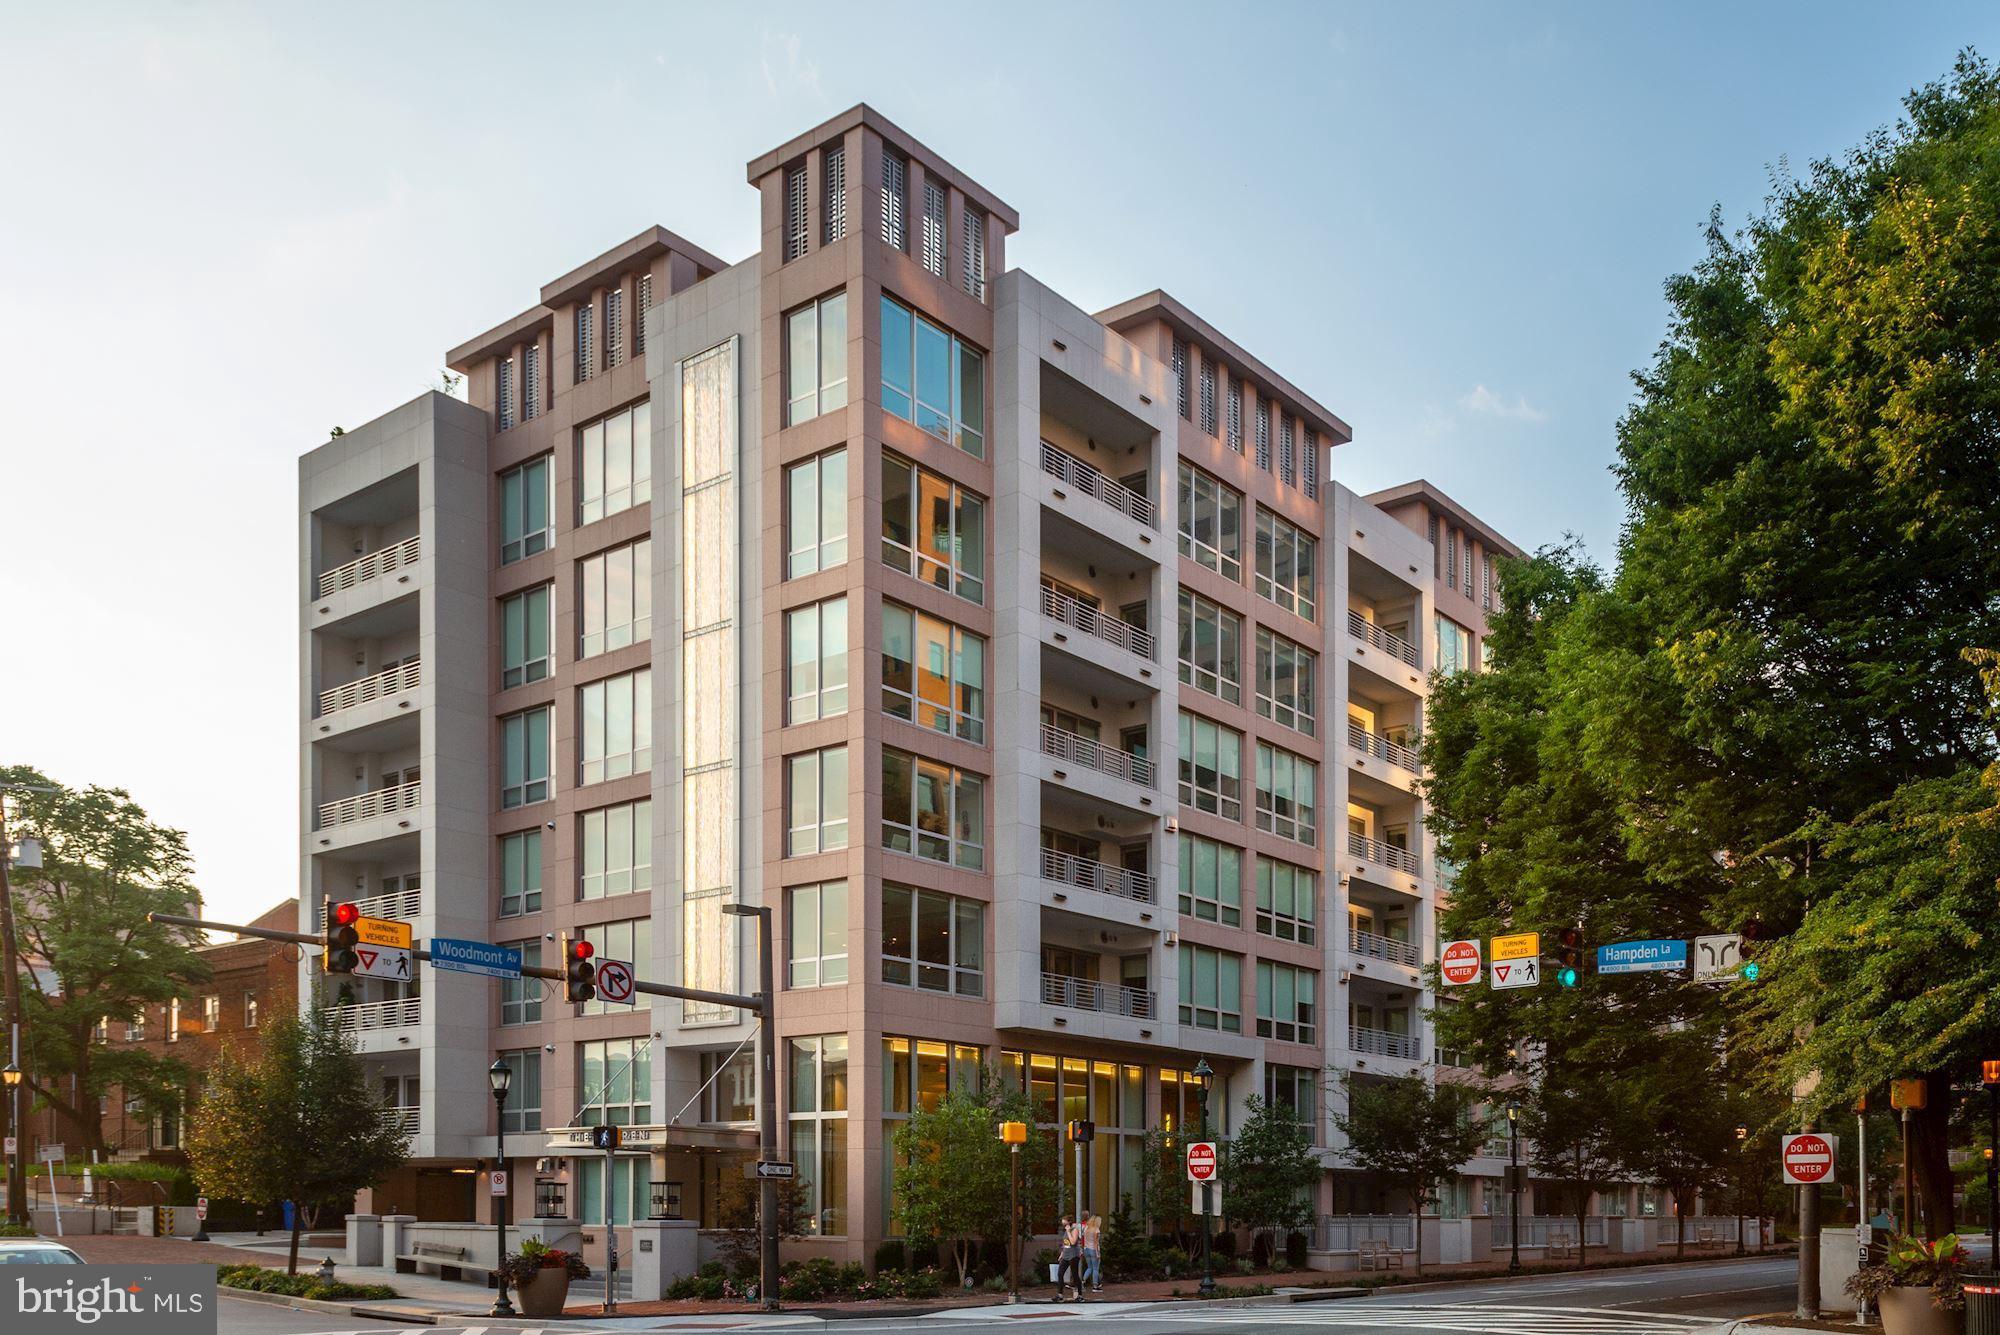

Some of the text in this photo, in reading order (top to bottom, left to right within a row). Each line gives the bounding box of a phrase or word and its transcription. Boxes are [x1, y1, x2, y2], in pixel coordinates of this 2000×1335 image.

[368, 922, 399, 934] TURNING
[365, 932, 400, 944] VEHICLES
[1502, 939, 1527, 948] TURNING
[438, 941, 518, 964] Woodmont Av
[1447, 948, 1474, 959] DO NOT
[1500, 947, 1529, 957] VEHICLES
[1605, 943, 1671, 962] Hampden La
[382, 958, 392, 966] TO
[1450, 968, 1472, 977] ENTER
[1790, 1143, 1825, 1153] DO NOT
[1793, 1164, 1822, 1174] ENTER
